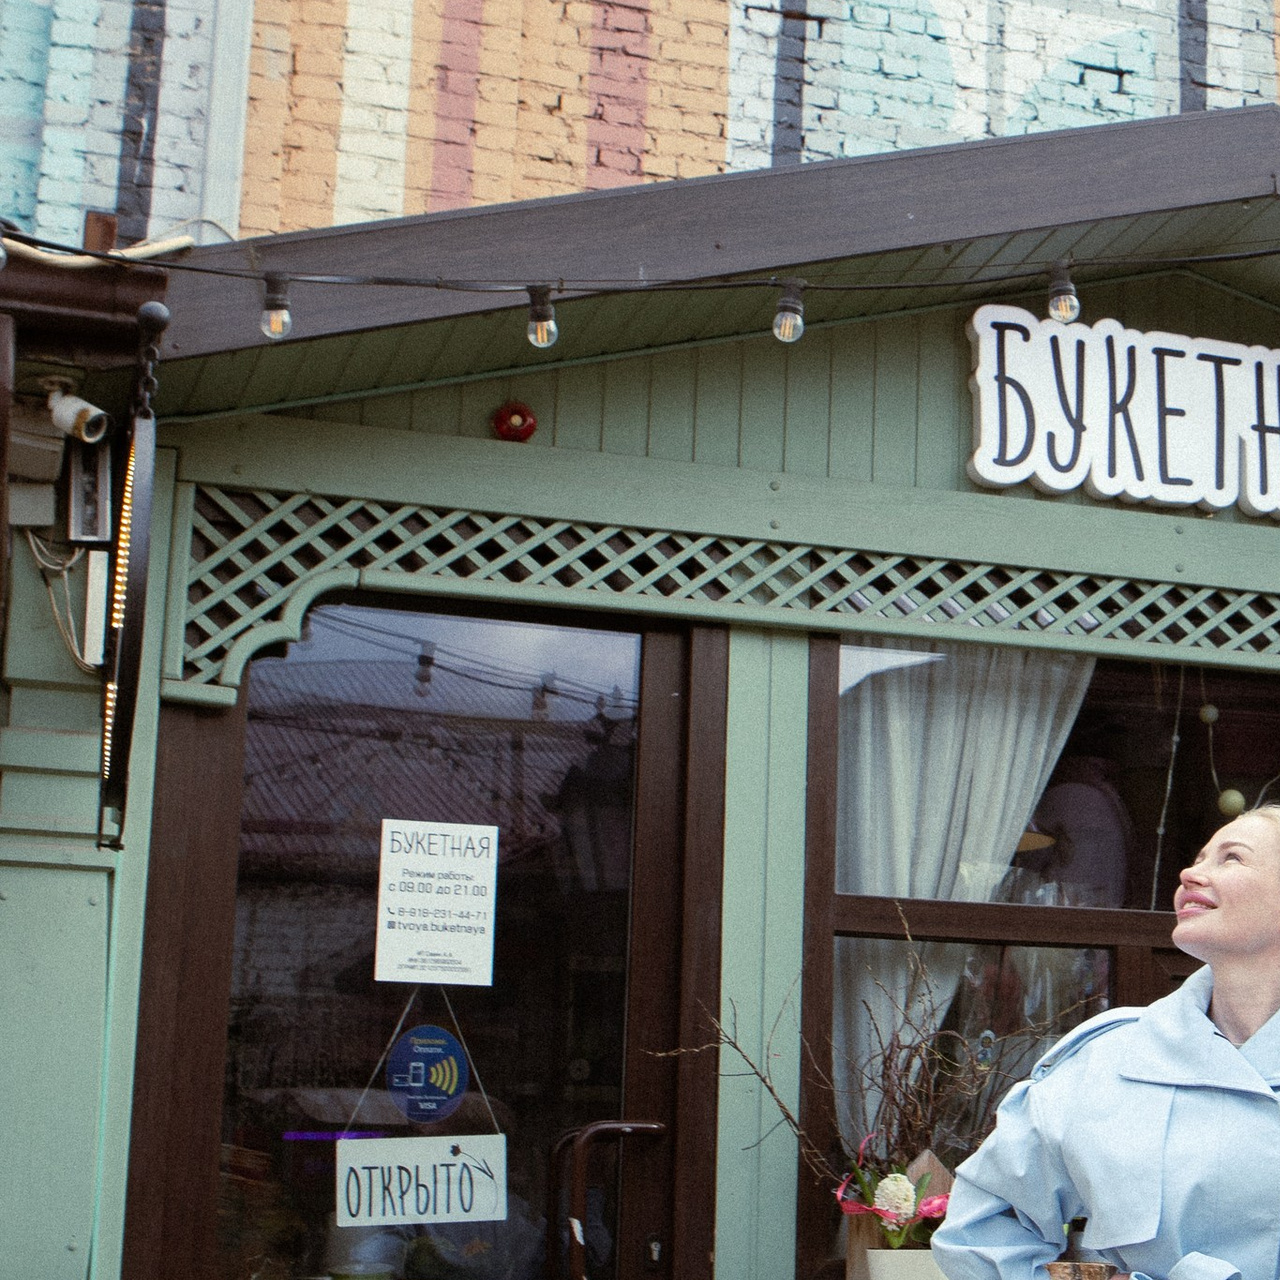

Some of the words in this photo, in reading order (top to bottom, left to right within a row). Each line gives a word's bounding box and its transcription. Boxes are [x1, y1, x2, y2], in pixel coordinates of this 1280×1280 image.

[390, 830, 491, 858] БУКЕТНАЯ
[436, 886, 451, 894] до
[346, 1162, 474, 1218] ОТКРЫТО
